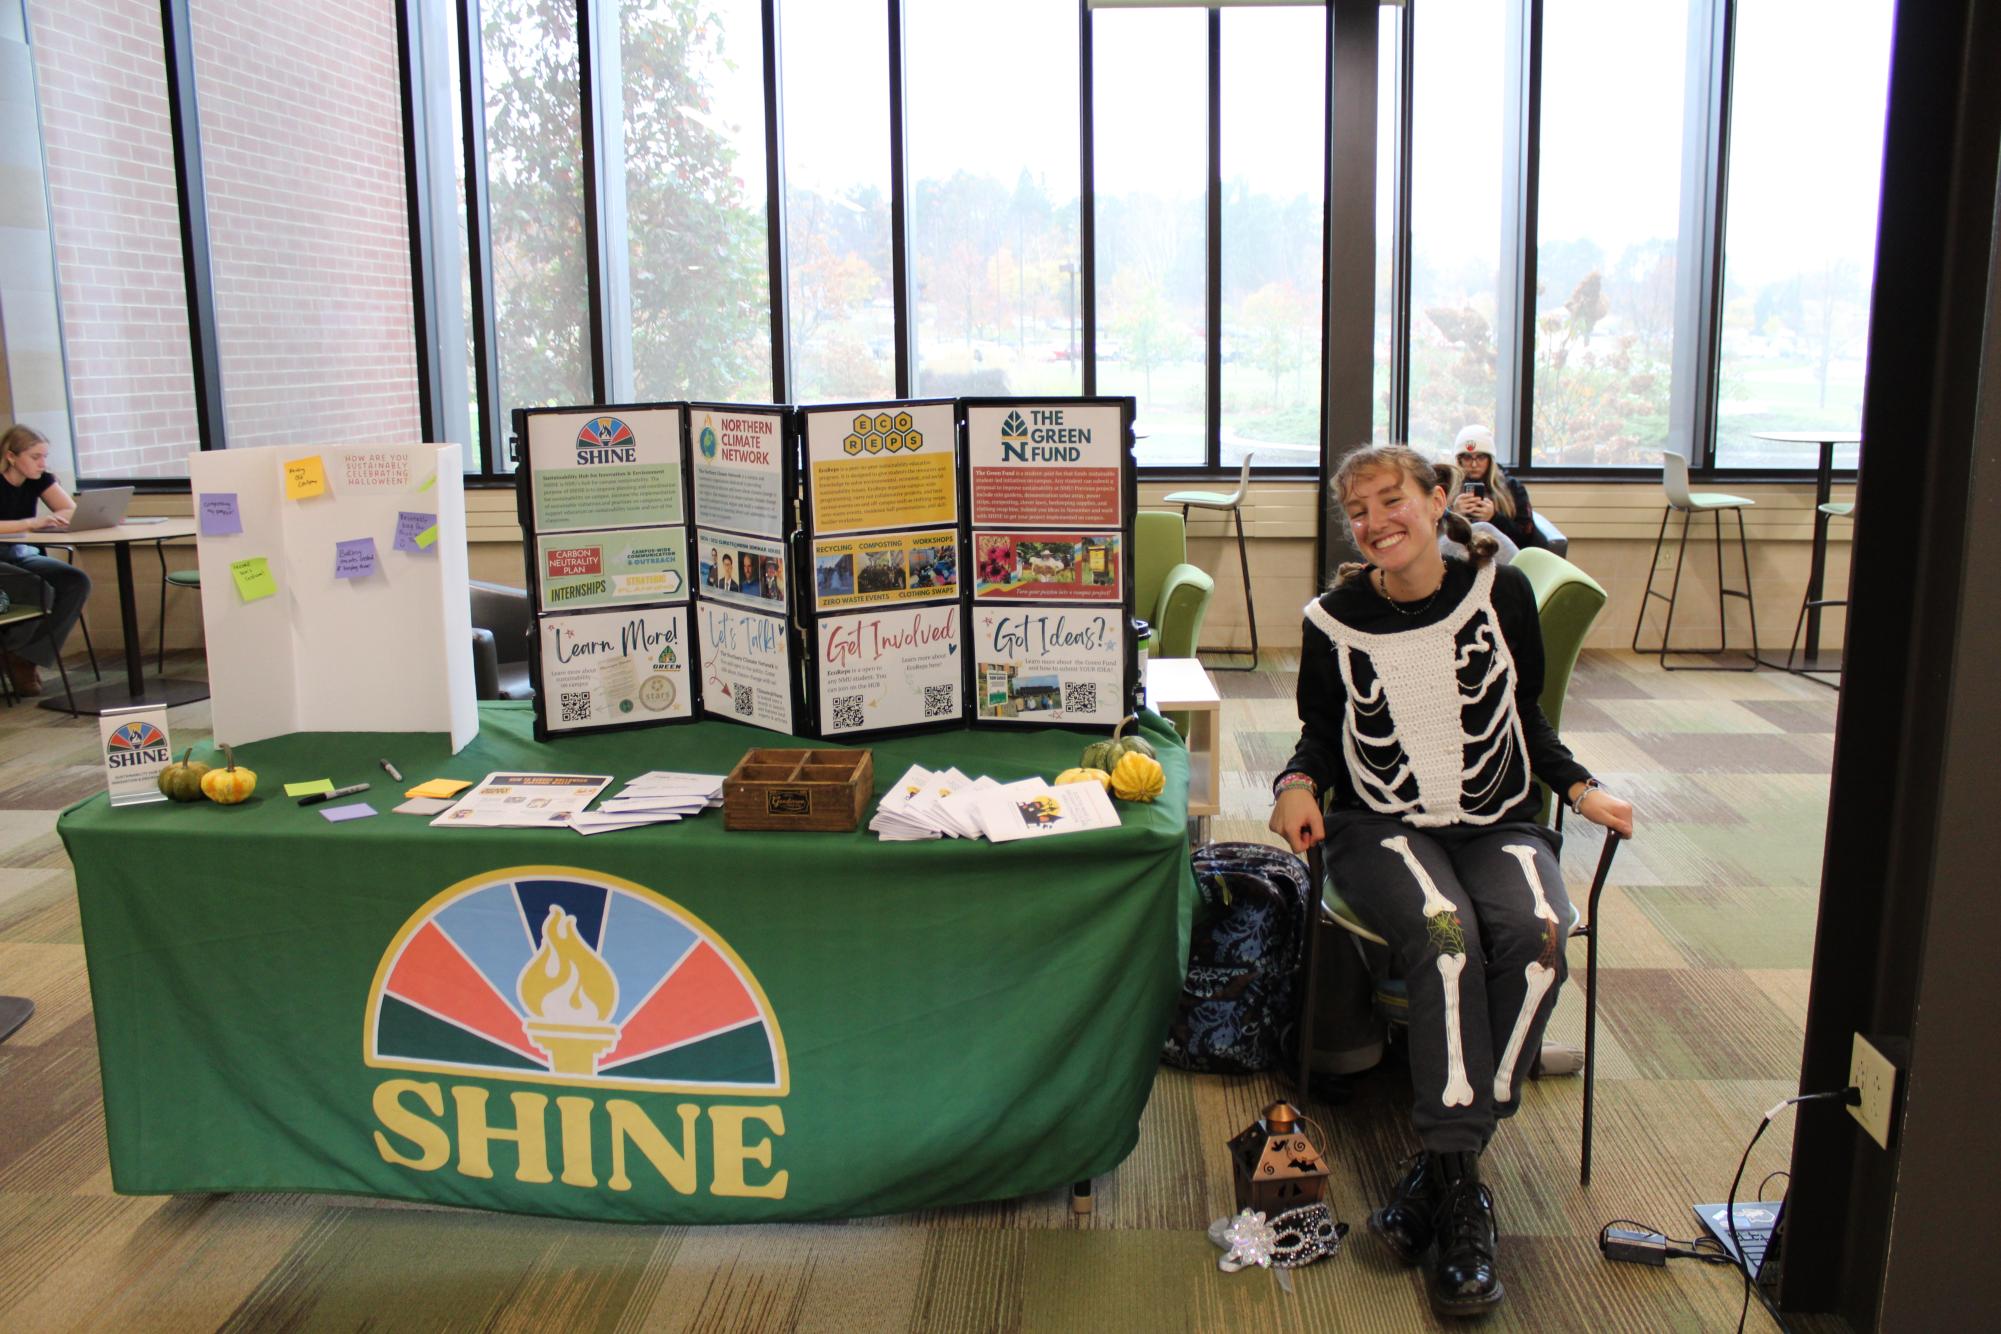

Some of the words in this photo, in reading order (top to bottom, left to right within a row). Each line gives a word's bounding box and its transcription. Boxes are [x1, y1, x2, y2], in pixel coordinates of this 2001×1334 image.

[860, 418, 907, 430] ECO
[1030, 410, 1063, 425] THE
[721, 418, 772, 434] NORTHERN
[721, 434, 760, 448] CLIMATE
[850, 436, 917, 449] REPS
[1030, 428, 1091, 444] GREEN
[577, 448, 636, 465] SHINE
[721, 449, 769, 465] NETWORK
[1001, 442, 1029, 462] N
[1032, 446, 1080, 462] FUND
[346, 462, 408, 470] SUSTAINABLY
[346, 470, 408, 478] CELEBRATING
[858, 541, 902, 550] COMPOSTING
[912, 536, 953, 545] WORKSHOPS
[555, 550, 591, 559] CARBON
[816, 544, 853, 553] RECYCLING
[549, 557, 599, 567] NEUTRALITY
[563, 566, 586, 574] PLAN
[551, 580, 606, 602] INTERNSHIPS
[898, 590, 930, 599] CLOTHING
[931, 587, 953, 595] SWAPS
[823, 598, 841, 606] ZERO
[841, 596, 865, 604] WASTE
[865, 594, 890, 602] EVENTS
[556, 628, 614, 664] Learn
[622, 617, 678, 657] More!
[740, 617, 776, 656] Talk!
[827, 620, 862, 667] Get
[870, 607, 955, 661] Involved
[994, 615, 1029, 659] Got
[1038, 616, 1106, 656] Ideas?
[645, 692, 670, 700] stars
[108, 748, 169, 769] SHINE
[372, 1078, 789, 1199] SHINE
